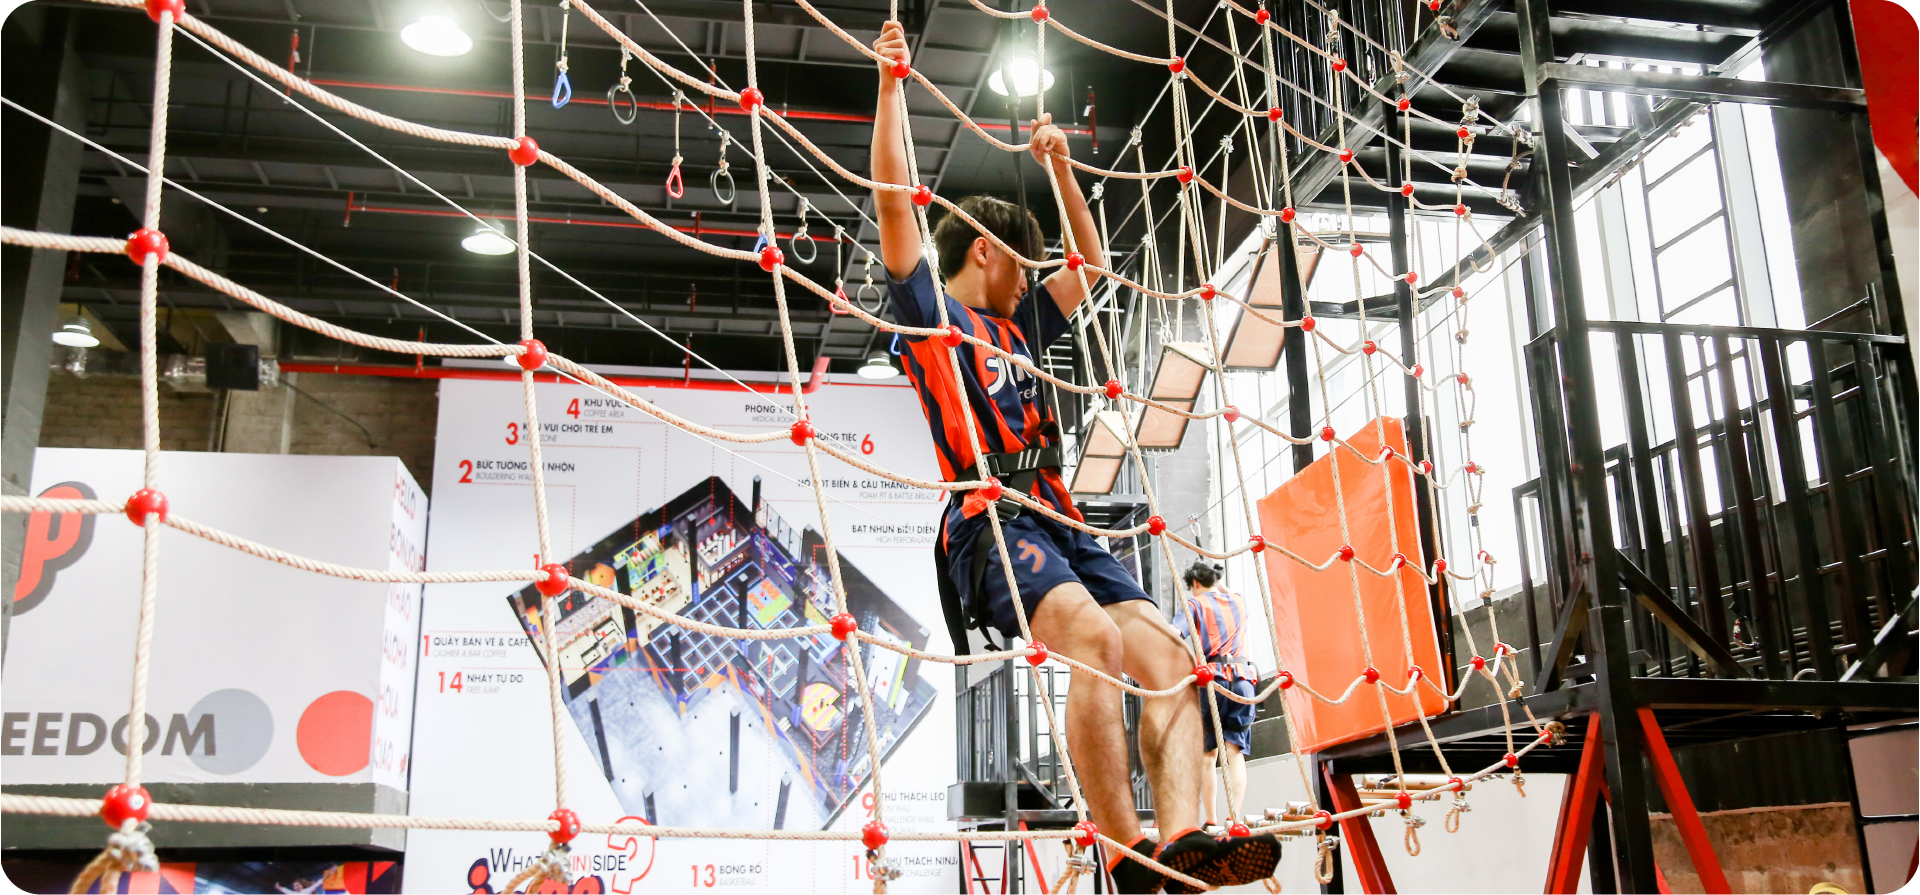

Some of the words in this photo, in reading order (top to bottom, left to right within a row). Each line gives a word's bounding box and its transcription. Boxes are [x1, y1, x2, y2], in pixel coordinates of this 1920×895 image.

[567, 398, 581, 419] 4
[584, 399, 603, 408] KHU
[584, 409, 607, 418] COFFEE
[608, 410, 625, 418] AREA
[506, 422, 519, 445] 3
[544, 423, 559, 432] VUI
[602, 425, 614, 434] EM
[815, 430, 839, 441] HÒNG
[861, 433, 875, 455] 6
[458, 459, 473, 483] 2
[475, 472, 516, 481] BOULDERING
[518, 472, 534, 481] WAL
[852, 480, 858, 489] &
[393, 470, 416, 520] HELLO
[859, 491, 878, 499] FOAM
[894, 492, 914, 500] BATTLE
[877, 536, 892, 544] HIGH
[424, 634, 430, 657] 1
[498, 637, 505, 647] &
[483, 649, 507, 658] COFFEE
[438, 672, 464, 693] 14
[510, 674, 524, 683] DO
[467, 686, 481, 694] FREE
[930, 792, 945, 801] LEO
[861, 792, 875, 818] 9
[691, 864, 716, 888] 13
[719, 878, 756, 886] BASKETBALL
